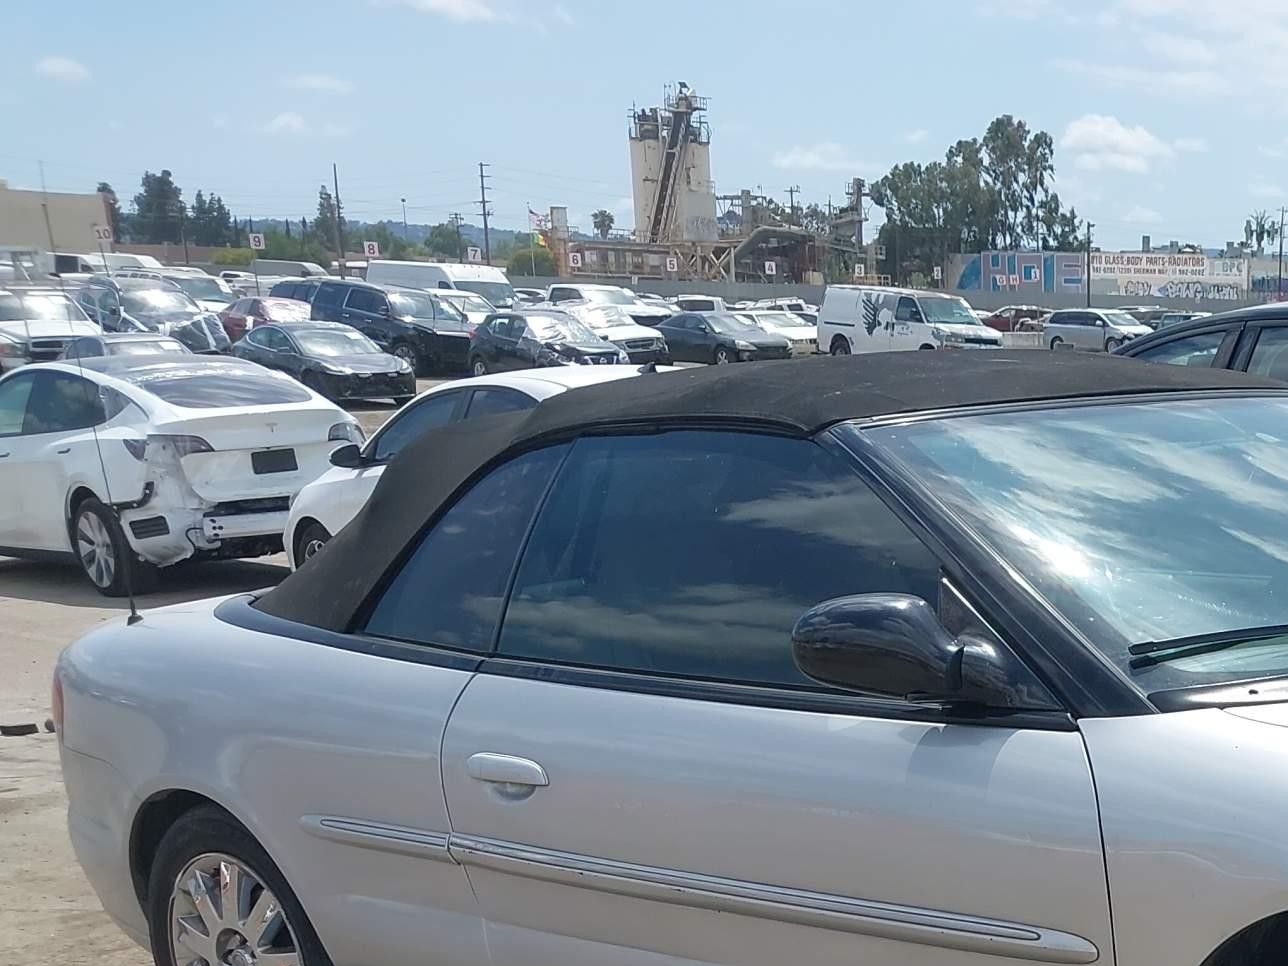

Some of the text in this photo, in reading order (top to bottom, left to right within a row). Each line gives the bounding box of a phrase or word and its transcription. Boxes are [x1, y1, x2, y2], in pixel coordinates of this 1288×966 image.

[95, 229, 111, 239] 10
[253, 235, 261, 247] 9
[367, 243, 375, 254] 8
